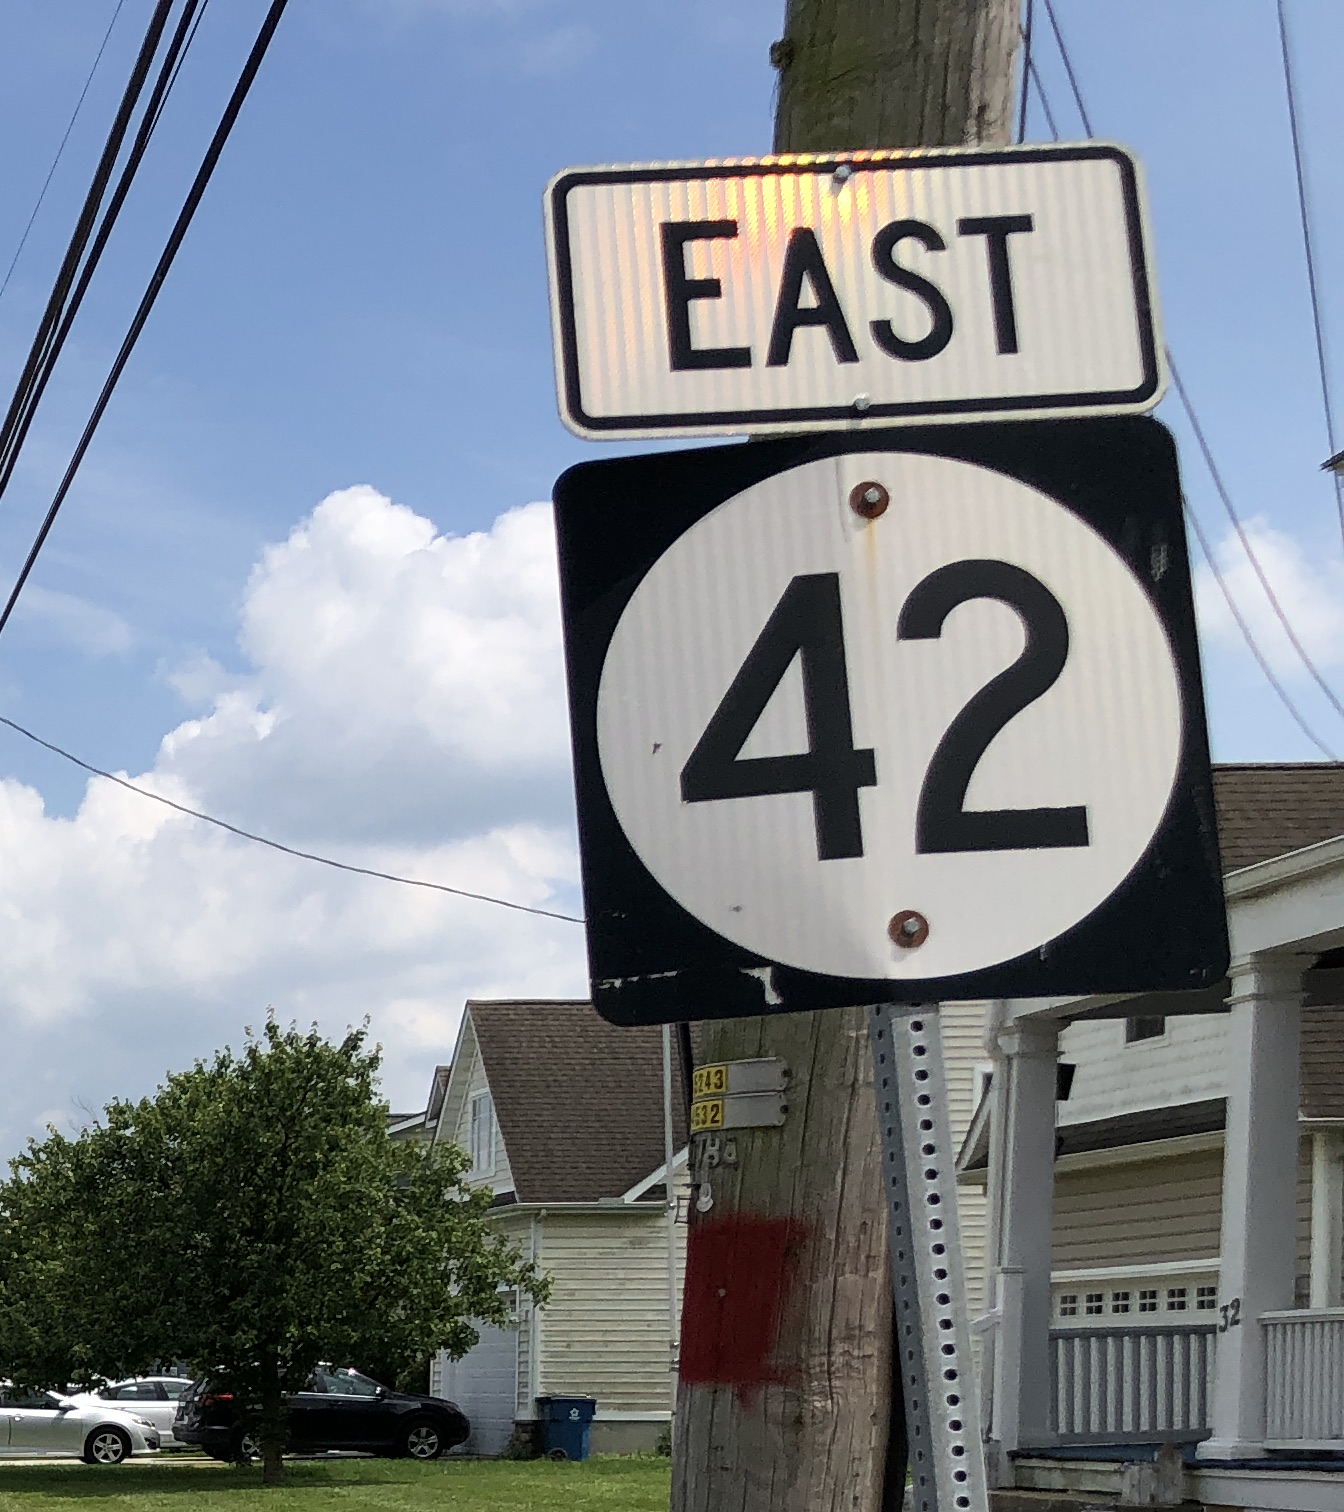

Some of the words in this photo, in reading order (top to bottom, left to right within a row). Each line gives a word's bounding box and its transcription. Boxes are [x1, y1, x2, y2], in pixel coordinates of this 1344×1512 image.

[660, 213, 1034, 373] EAST
[680, 558, 1089, 861] 42
[1219, 1298, 1241, 1333] 32
